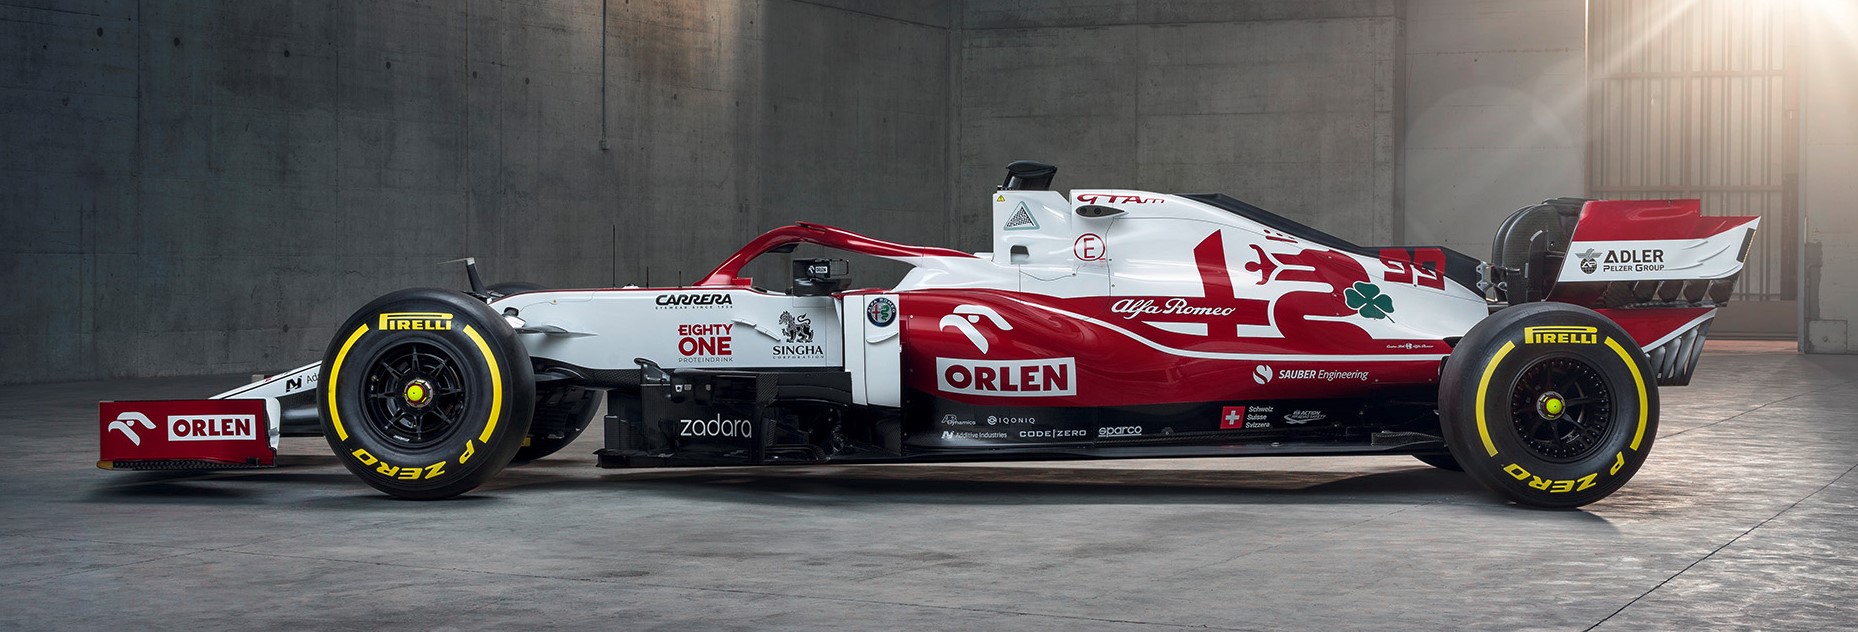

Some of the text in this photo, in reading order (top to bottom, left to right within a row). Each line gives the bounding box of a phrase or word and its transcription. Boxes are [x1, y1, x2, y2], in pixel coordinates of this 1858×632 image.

[1084, 238, 1095, 258] E
[1603, 250, 1664, 263] ADLER
[1379, 248, 1446, 291] 99
[655, 294, 733, 305] CARRERA
[1111, 298, 1236, 319] Alfa Romeo
[379, 312, 453, 330] PIRELLI
[678, 324, 733, 336] EIGHTY
[1524, 325, 1598, 344] PIRELLI
[678, 337, 732, 356] ONE
[773, 345, 824, 355] SINGHA
[945, 364, 1068, 391] ORLEN
[1279, 369, 1369, 381] SAUBER Engineering
[173, 418, 251, 437] ORLEN
[680, 413, 752, 438] zadara
[999, 417, 1036, 425] IQONIQ
[955, 431, 978, 439] Additive
[979, 431, 1008, 439] Industries
[1098, 426, 1142, 438] sparco
[352, 440, 475, 480] P ZERO
[1503, 451, 1625, 493] P ZERO
